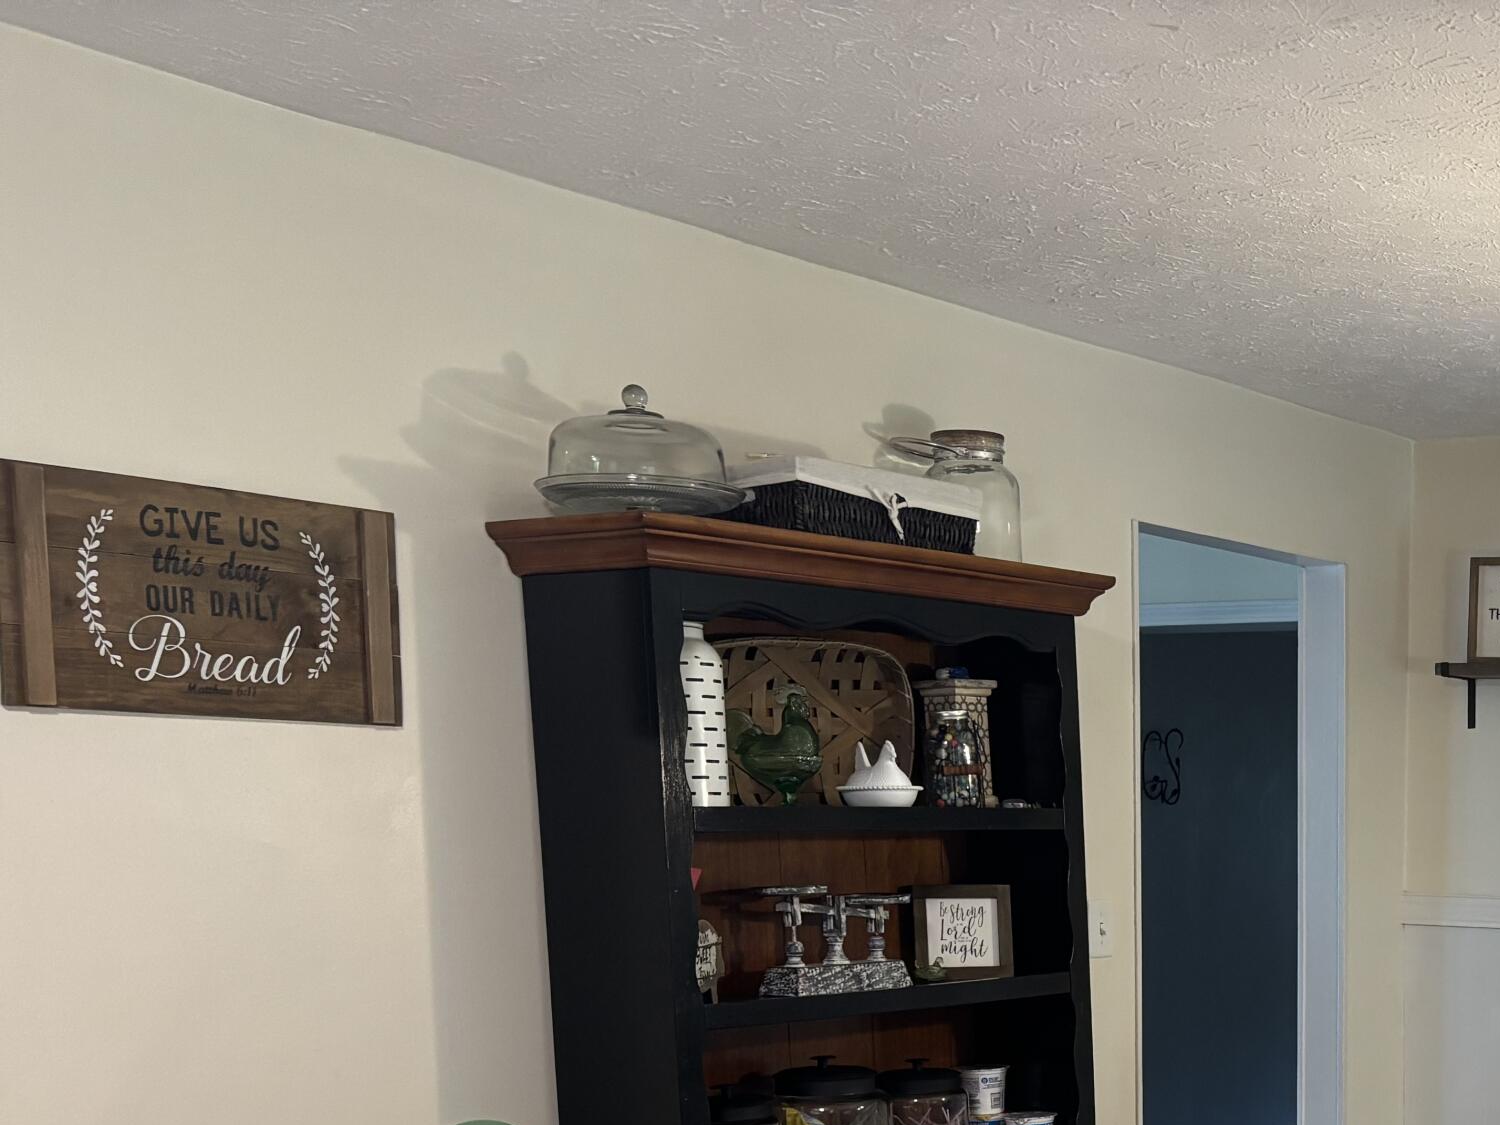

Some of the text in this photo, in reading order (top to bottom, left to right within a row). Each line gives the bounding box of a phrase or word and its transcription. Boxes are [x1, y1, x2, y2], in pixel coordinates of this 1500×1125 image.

[139, 504, 281, 551] GIVE US
[152, 545, 273, 592] this day
[145, 583, 281, 622] OUR DAILY
[128, 614, 301, 686] Bread
[940, 917, 976, 941] Lord
[941, 936, 988, 963] might
